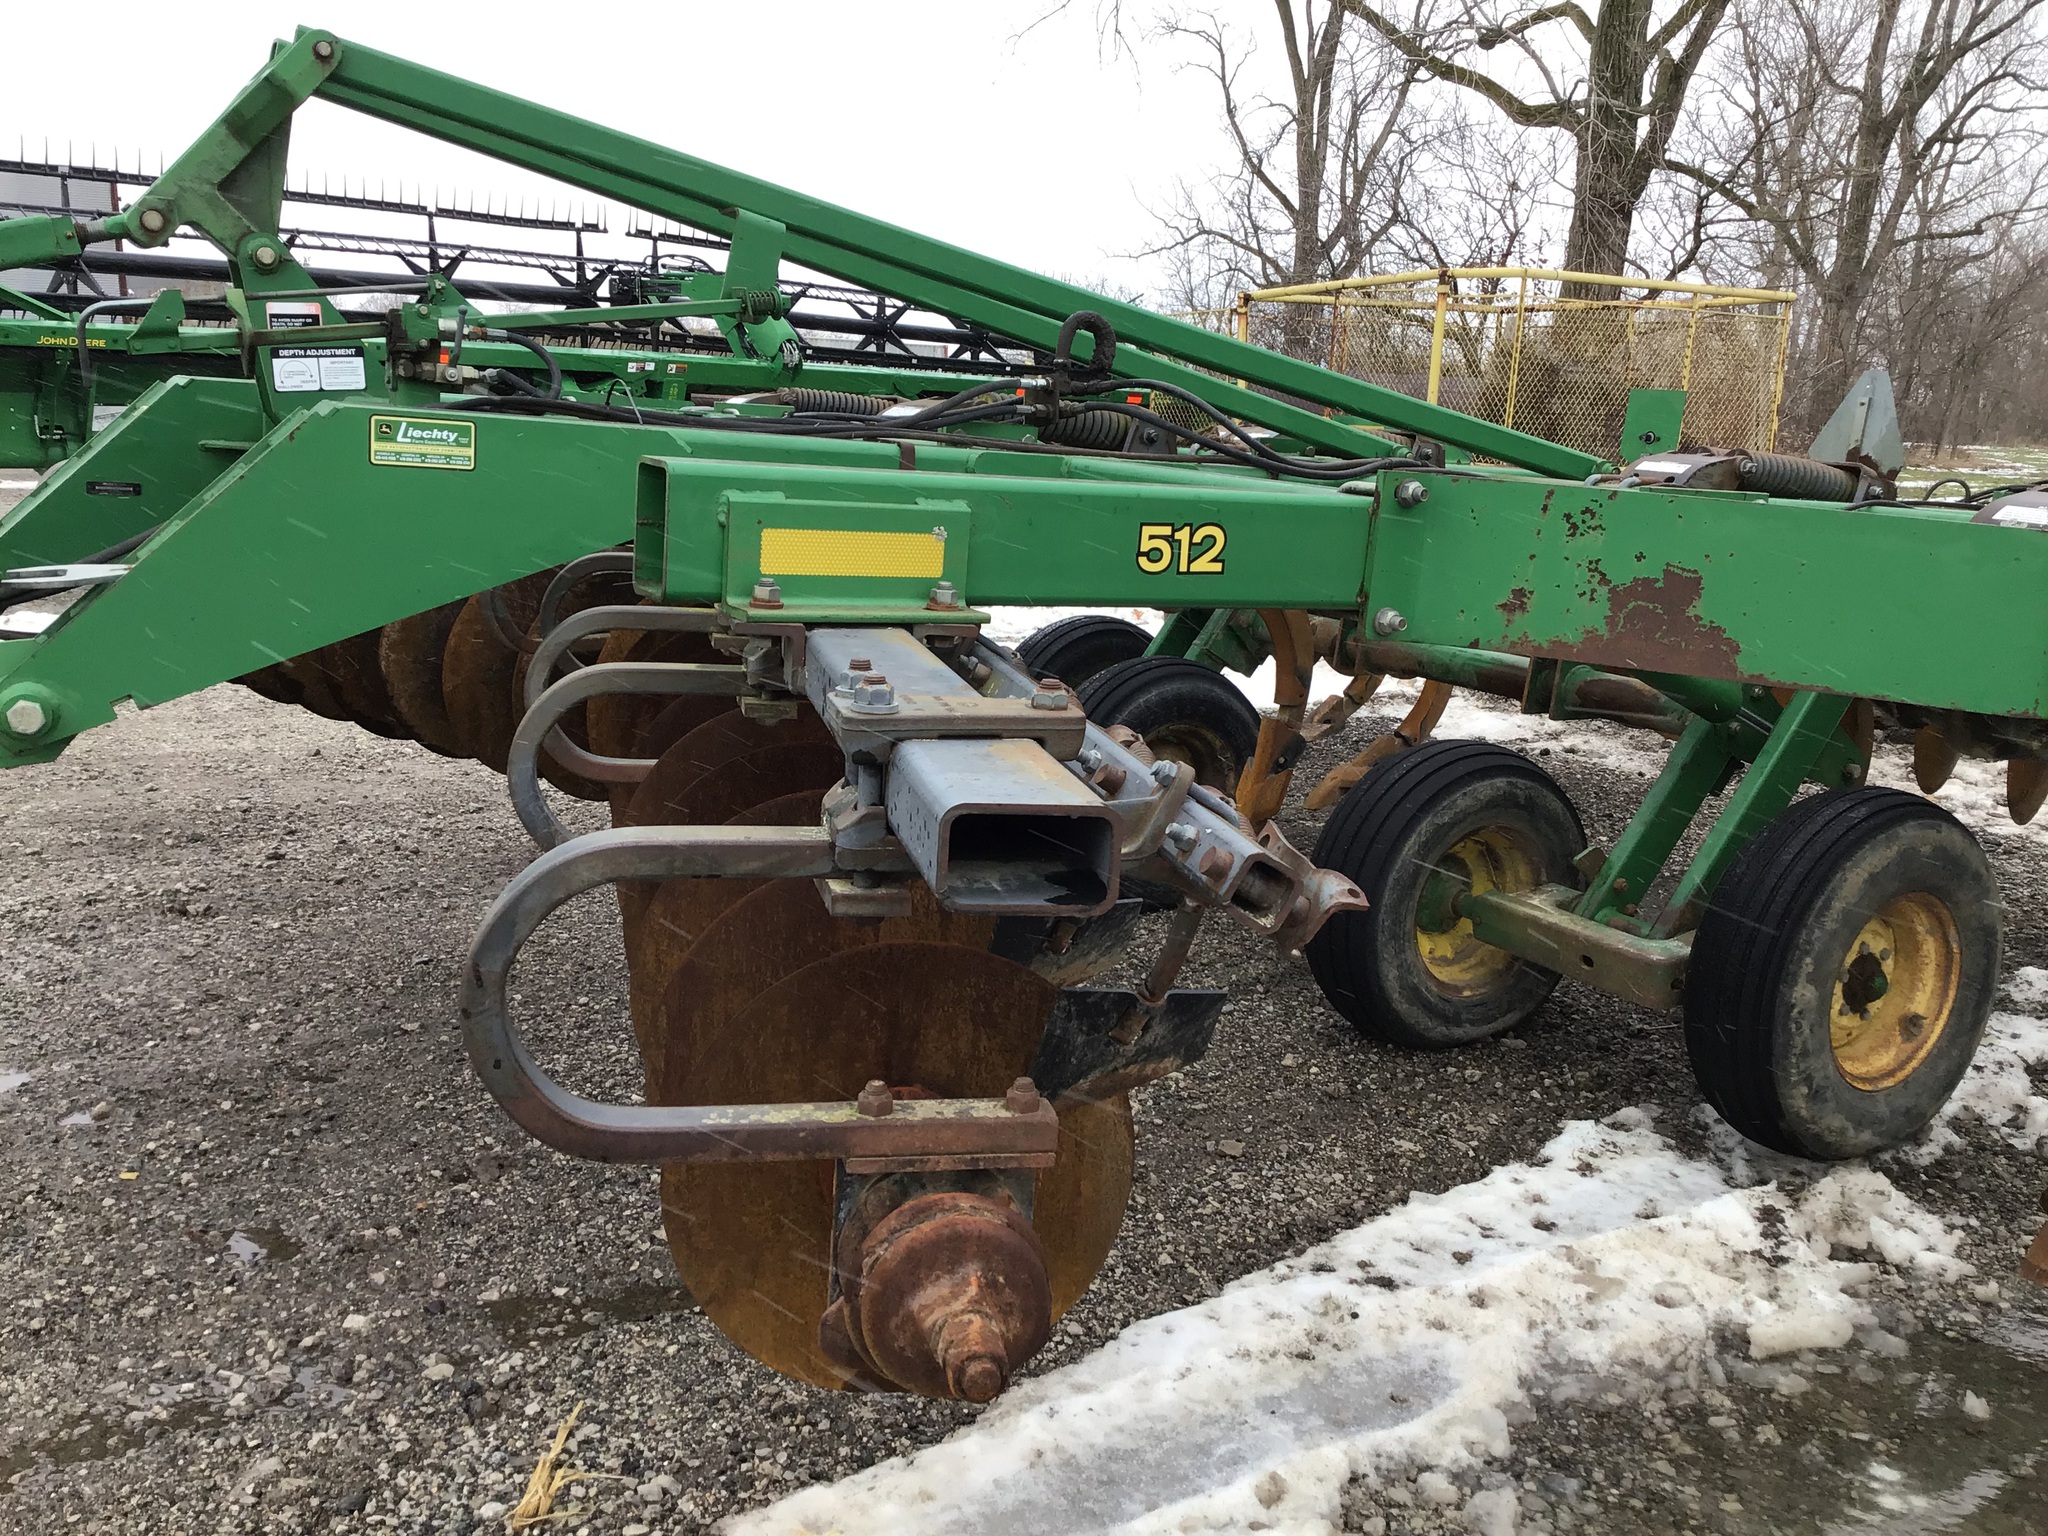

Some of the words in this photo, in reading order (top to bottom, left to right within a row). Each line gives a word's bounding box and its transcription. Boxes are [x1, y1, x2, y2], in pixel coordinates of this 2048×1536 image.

[36, 335, 68, 346] JOHN
[69, 336, 106, 347] DERE
[306, 348, 356, 356] ADJUSTMENT
[397, 421, 458, 442] Liechty
[1136, 522, 1228, 575] 512
